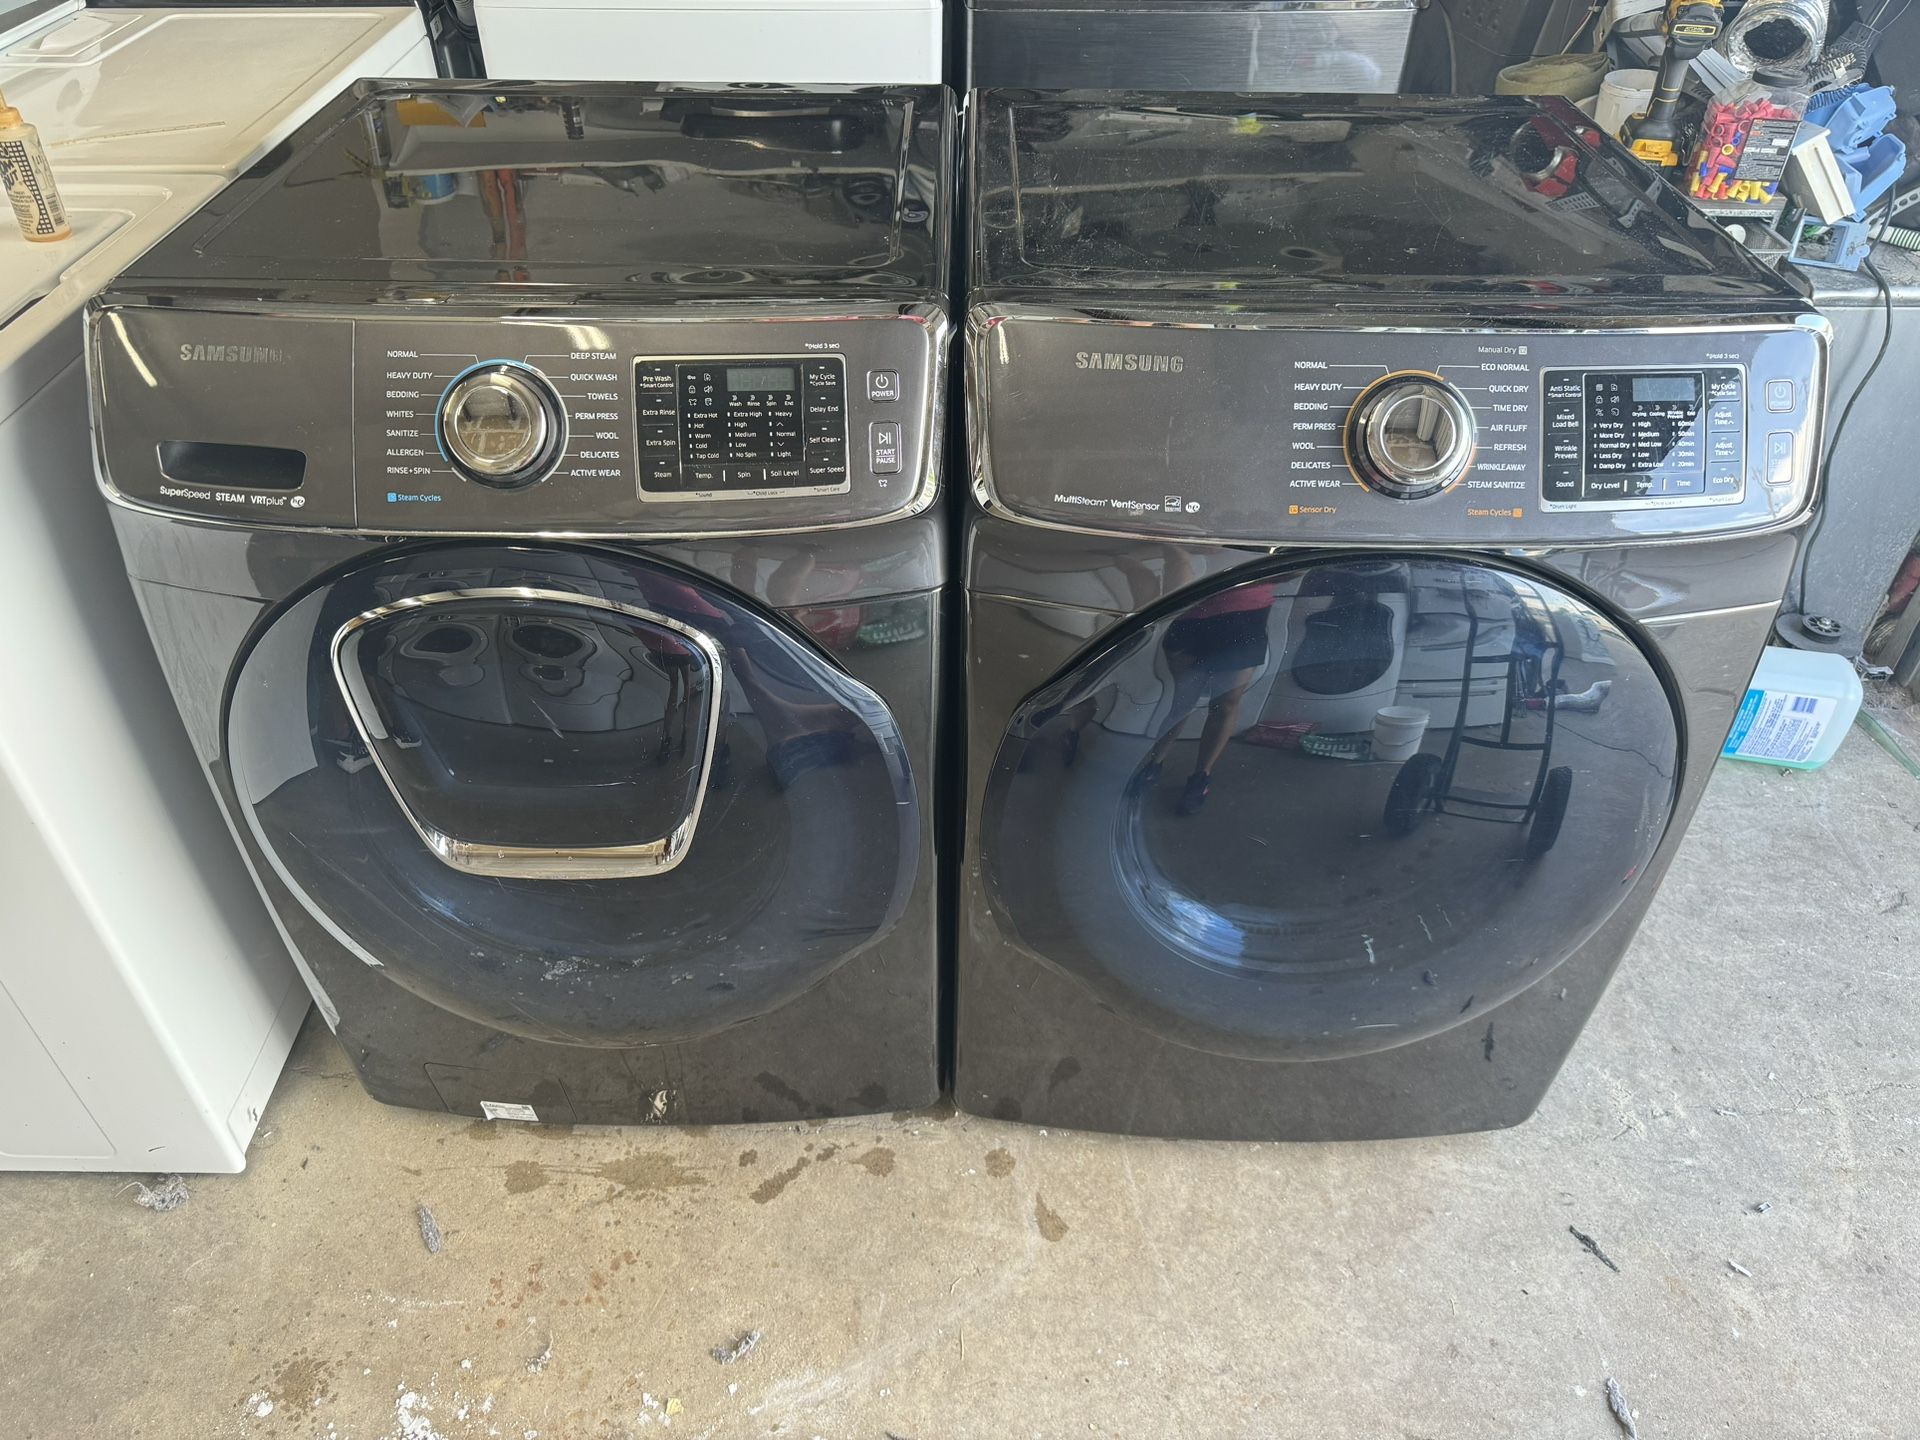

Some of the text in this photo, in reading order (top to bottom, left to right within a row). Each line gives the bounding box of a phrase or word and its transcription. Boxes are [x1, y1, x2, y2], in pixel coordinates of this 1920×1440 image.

[1503, 347, 1517, 355] Dry
[1075, 352, 1184, 373] SAMSUNG
[1481, 363, 1529, 371] ECO NORMAL
[1489, 385, 1529, 393] QUICK DRY
[1490, 424, 1528, 432] AIR FLUFF
[596, 432, 619, 440] WOOL
[1292, 442, 1315, 450] WOOL
[1715, 442, 1733, 450] Adjust
[1289, 480, 1340, 488] ACTIVE WEAR
[1724, 476, 1734, 484] Dry
[1467, 481, 1525, 489] STEAM SANITIZE
[160, 486, 211, 500] SuperSpeed
[215, 493, 245, 503] STEAM
[420, 494, 441, 502] Cycles
[1111, 499, 1160, 511] VentSensor
[1324, 506, 1337, 514] Dry
[1490, 508, 1511, 517] Cycles
